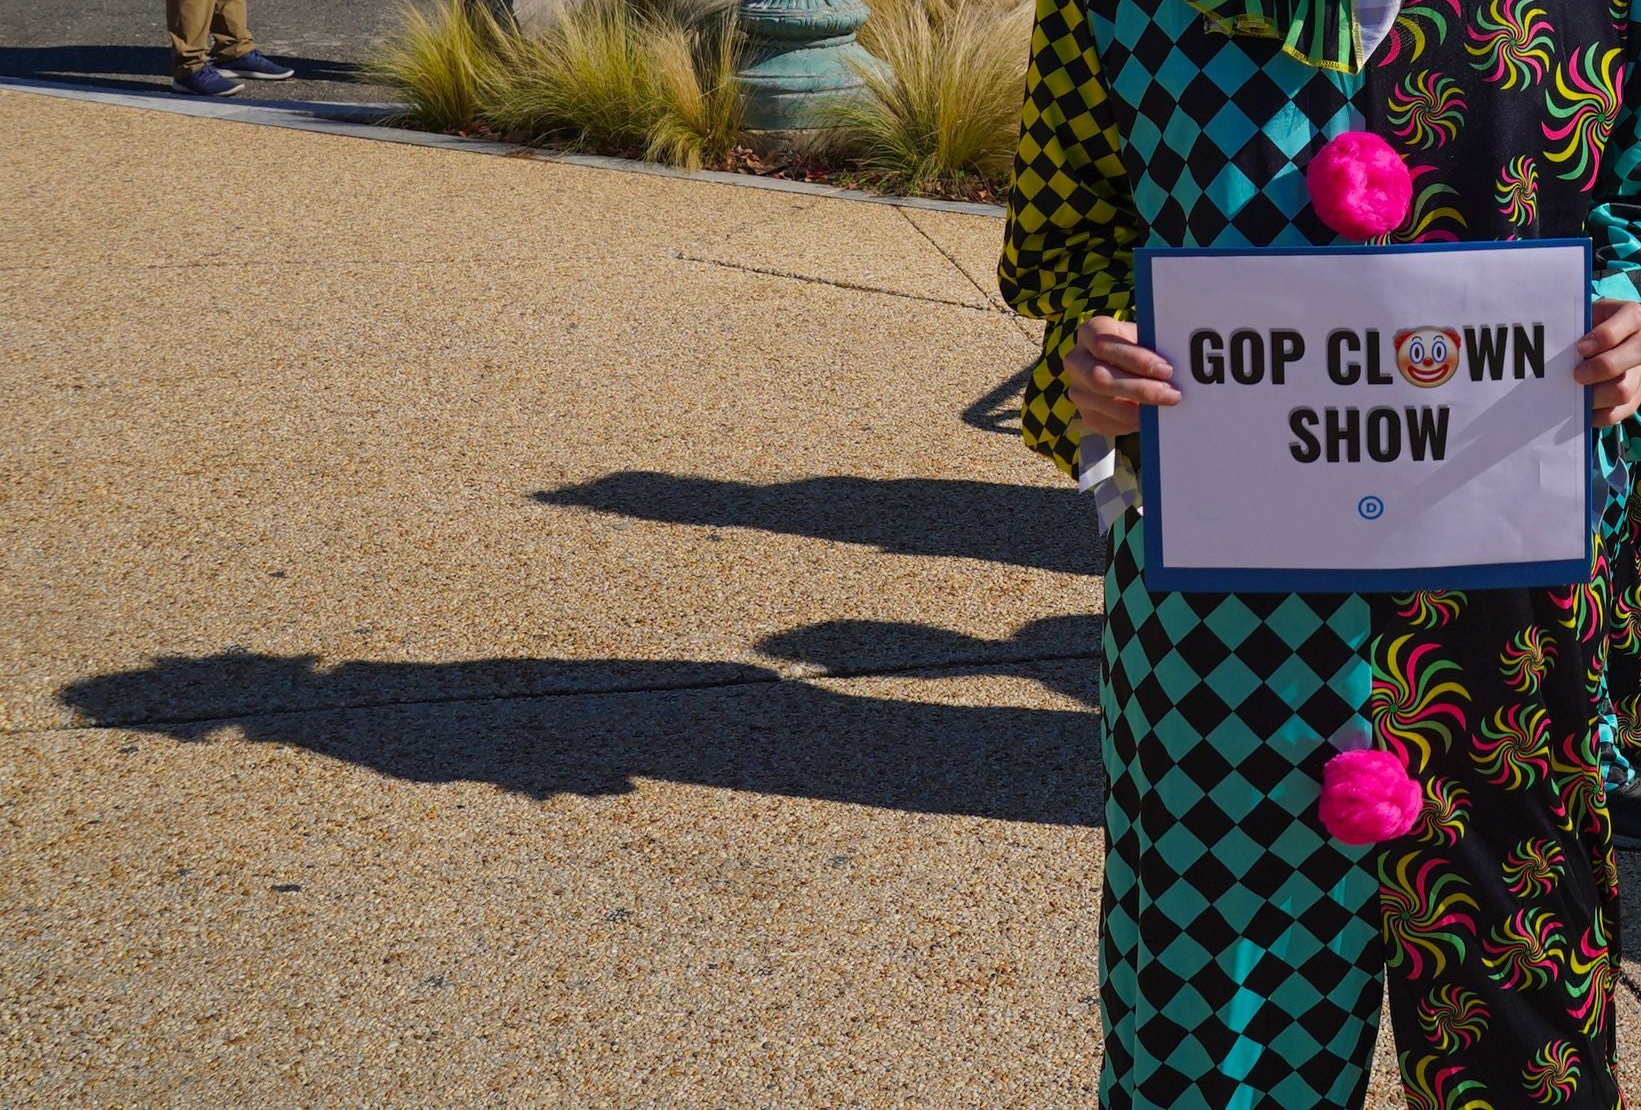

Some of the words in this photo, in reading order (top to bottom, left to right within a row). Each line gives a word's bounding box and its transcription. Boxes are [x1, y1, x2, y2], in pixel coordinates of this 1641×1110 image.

[1189, 327, 1306, 385] GOP
[1326, 323, 1546, 387] CLWN
[1288, 405, 1451, 464] SHOW
